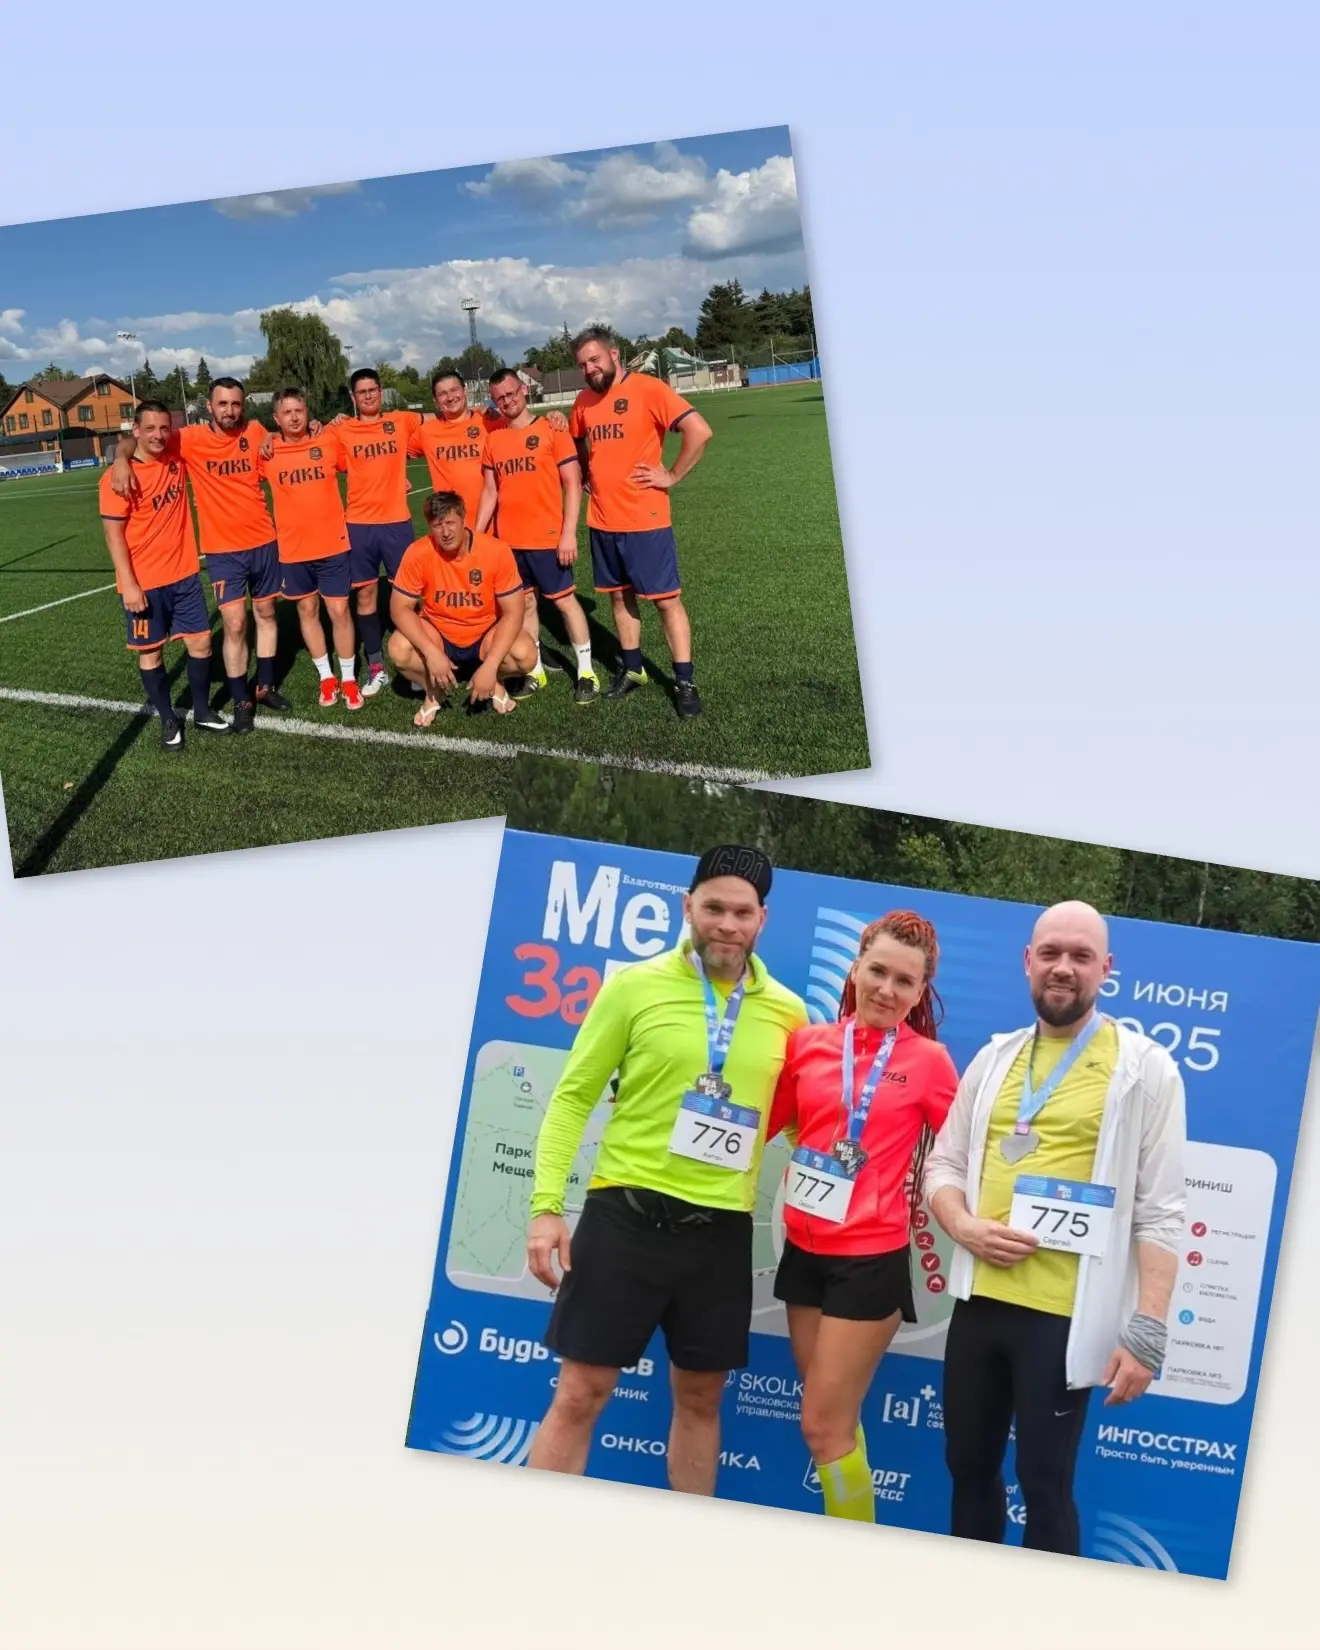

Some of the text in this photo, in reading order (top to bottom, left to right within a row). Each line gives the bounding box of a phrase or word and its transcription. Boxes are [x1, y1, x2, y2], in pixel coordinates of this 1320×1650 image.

[353, 440, 397, 459] РДКБ
[436, 444, 480, 461] РДКБ
[206, 459, 252, 477] РДКБ
[278, 466, 325, 486] РДКБ
[496, 456, 536, 477] РДКБ
[434, 590, 484, 608] РДКБ
[132, 619, 149, 639] 14
[622, 874, 691, 895] Благотвори
[542, 860, 690, 957] Ме
[505, 943, 604, 1026] За
[1098, 970, 1121, 997] 5
[1118, 1017, 1221, 1072] 25
[692, 1121, 742, 1154] 776
[495, 1143, 533, 1159] Парк
[793, 1172, 835, 1202] 777
[1031, 1205, 1090, 1238] 775
[738, 1391, 800, 1410] Московска
[1097, 1423, 1238, 1460] ИНГОССТРАХ
[1095, 1445, 1235, 1476] Просто быть уверенным
[873, 1469, 912, 1489] ОРТ
